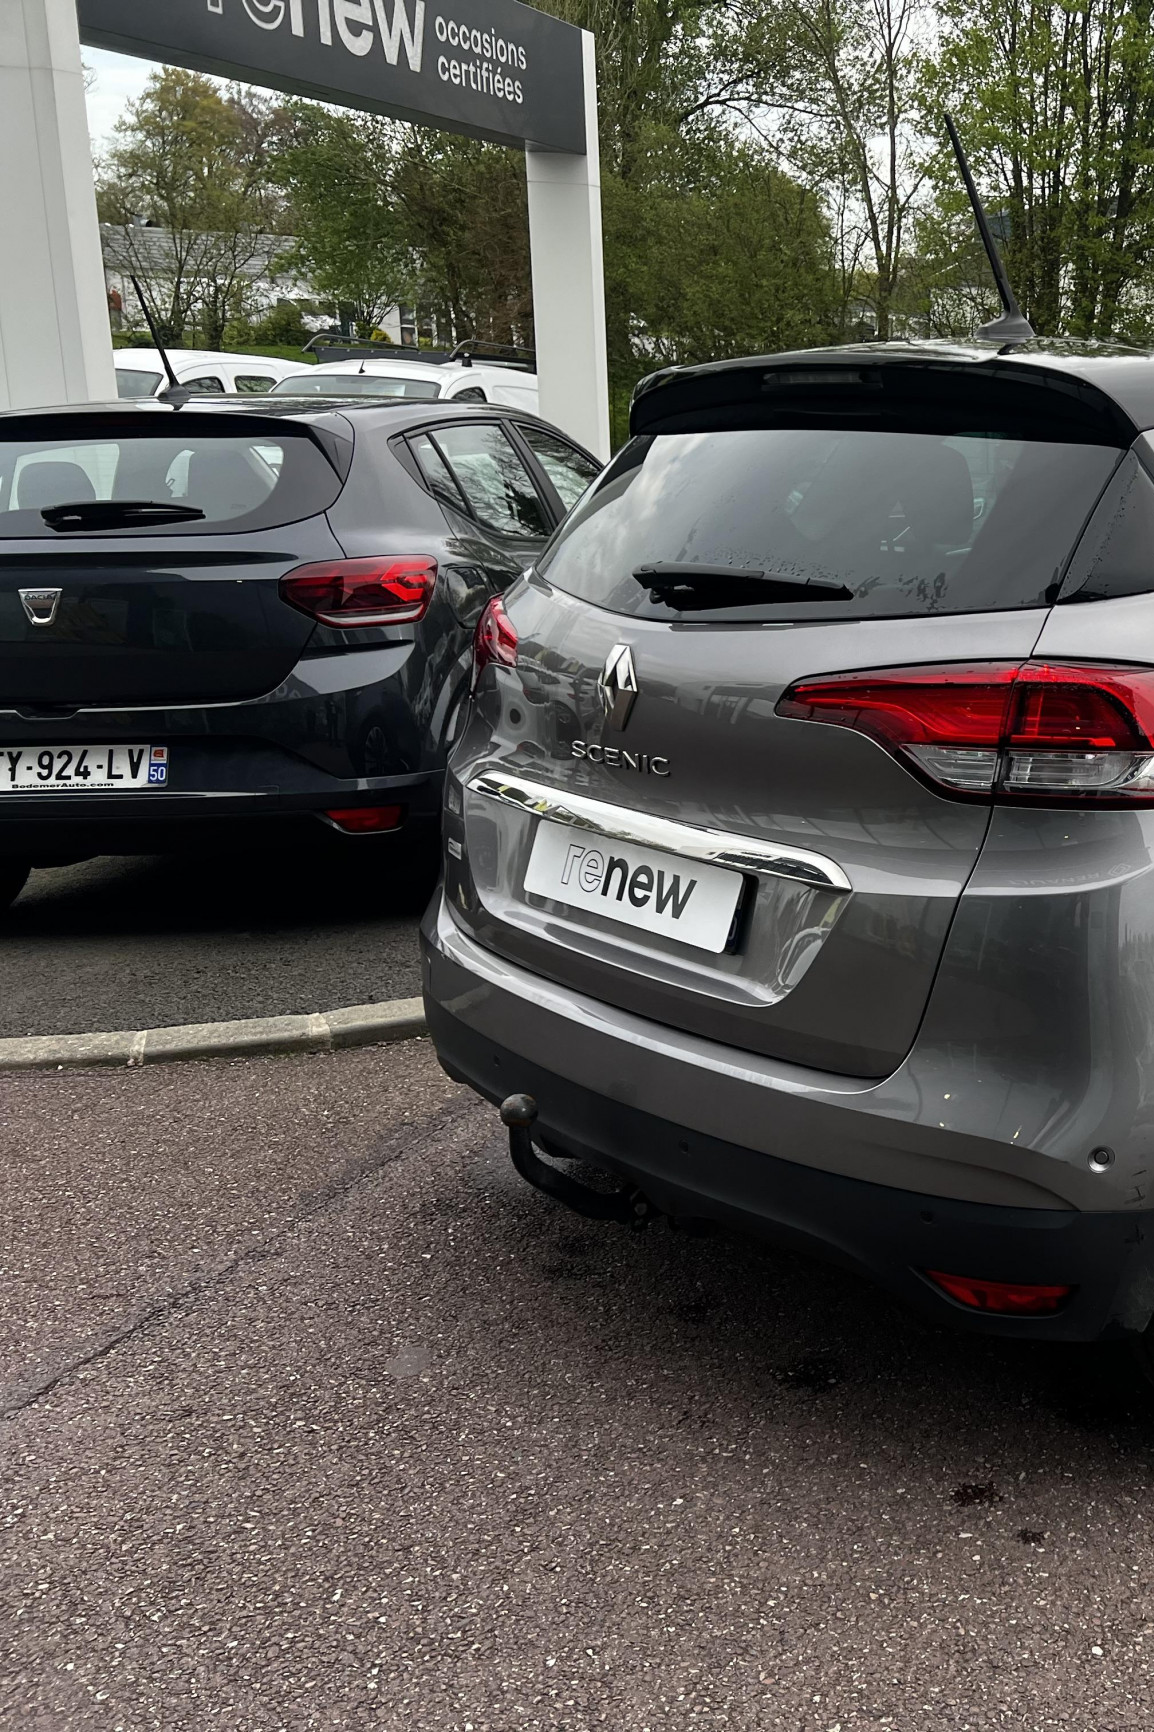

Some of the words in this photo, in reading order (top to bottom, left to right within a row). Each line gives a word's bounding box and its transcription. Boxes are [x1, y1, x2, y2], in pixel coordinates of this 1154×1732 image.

[207, 0, 425, 73] new
[435, 15, 527, 70] occasions
[437, 55, 523, 104] certifiées
[0, 748, 145, 782] Y-924-LV
[150, 766, 166, 781] 50
[571, 740, 671, 777] SCENIC
[560, 843, 698, 920] renew
